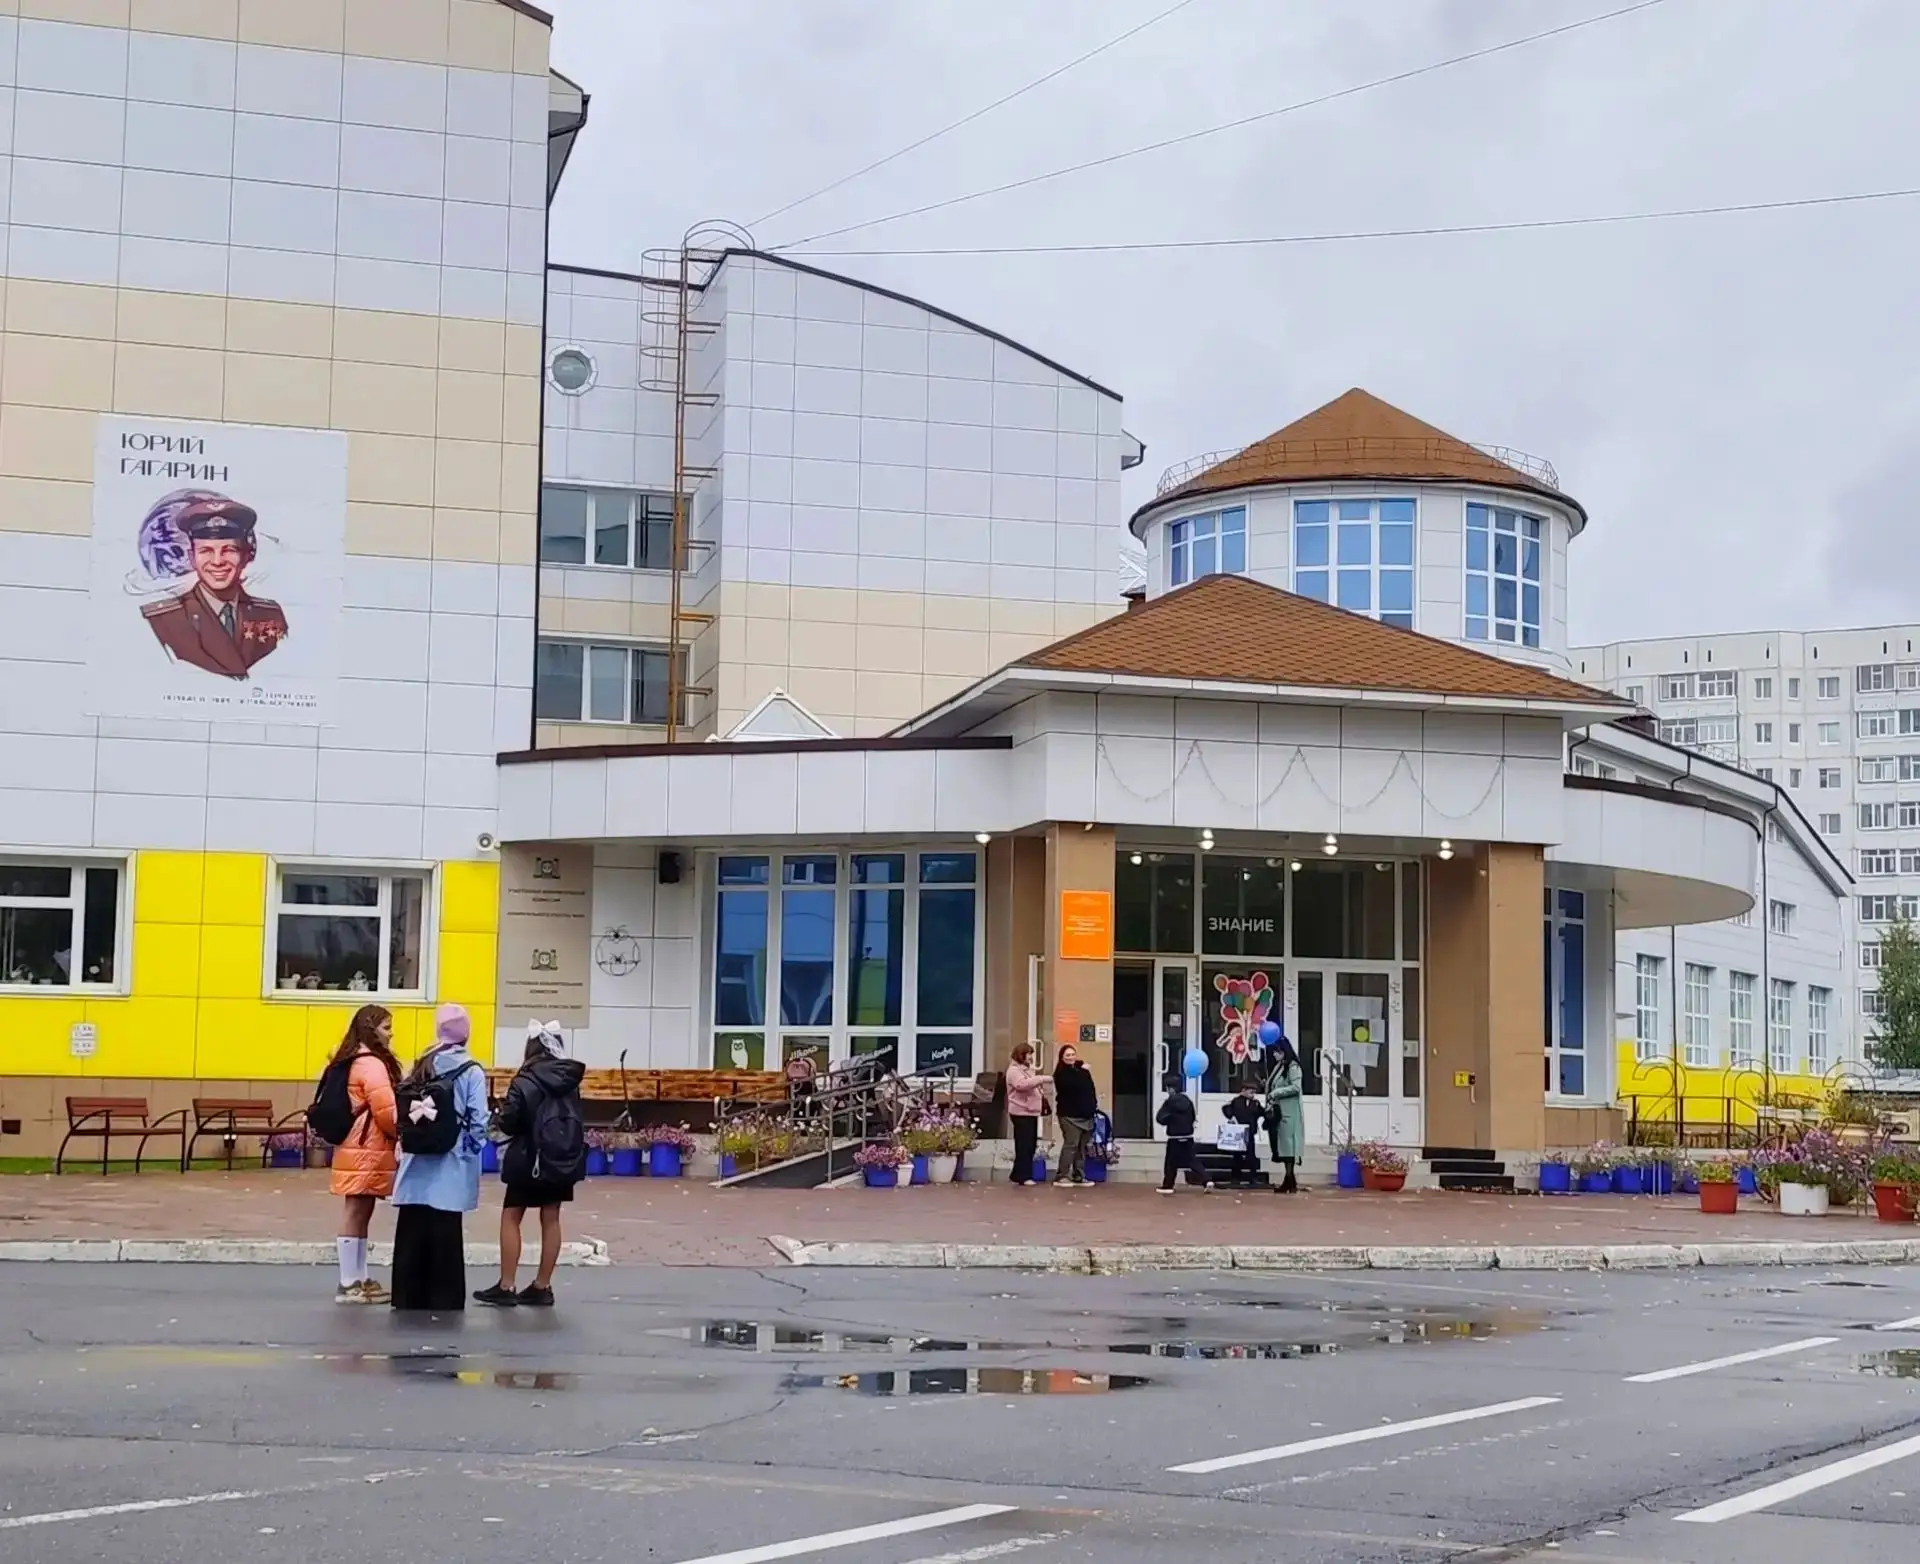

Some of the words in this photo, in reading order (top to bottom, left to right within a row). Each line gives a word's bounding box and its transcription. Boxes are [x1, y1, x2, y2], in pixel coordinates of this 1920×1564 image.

[122, 433, 203, 454] ЮРИЙ
[121, 458, 228, 481] ГАГАРИН
[1208, 917, 1274, 932] ЗНАНИЕ
